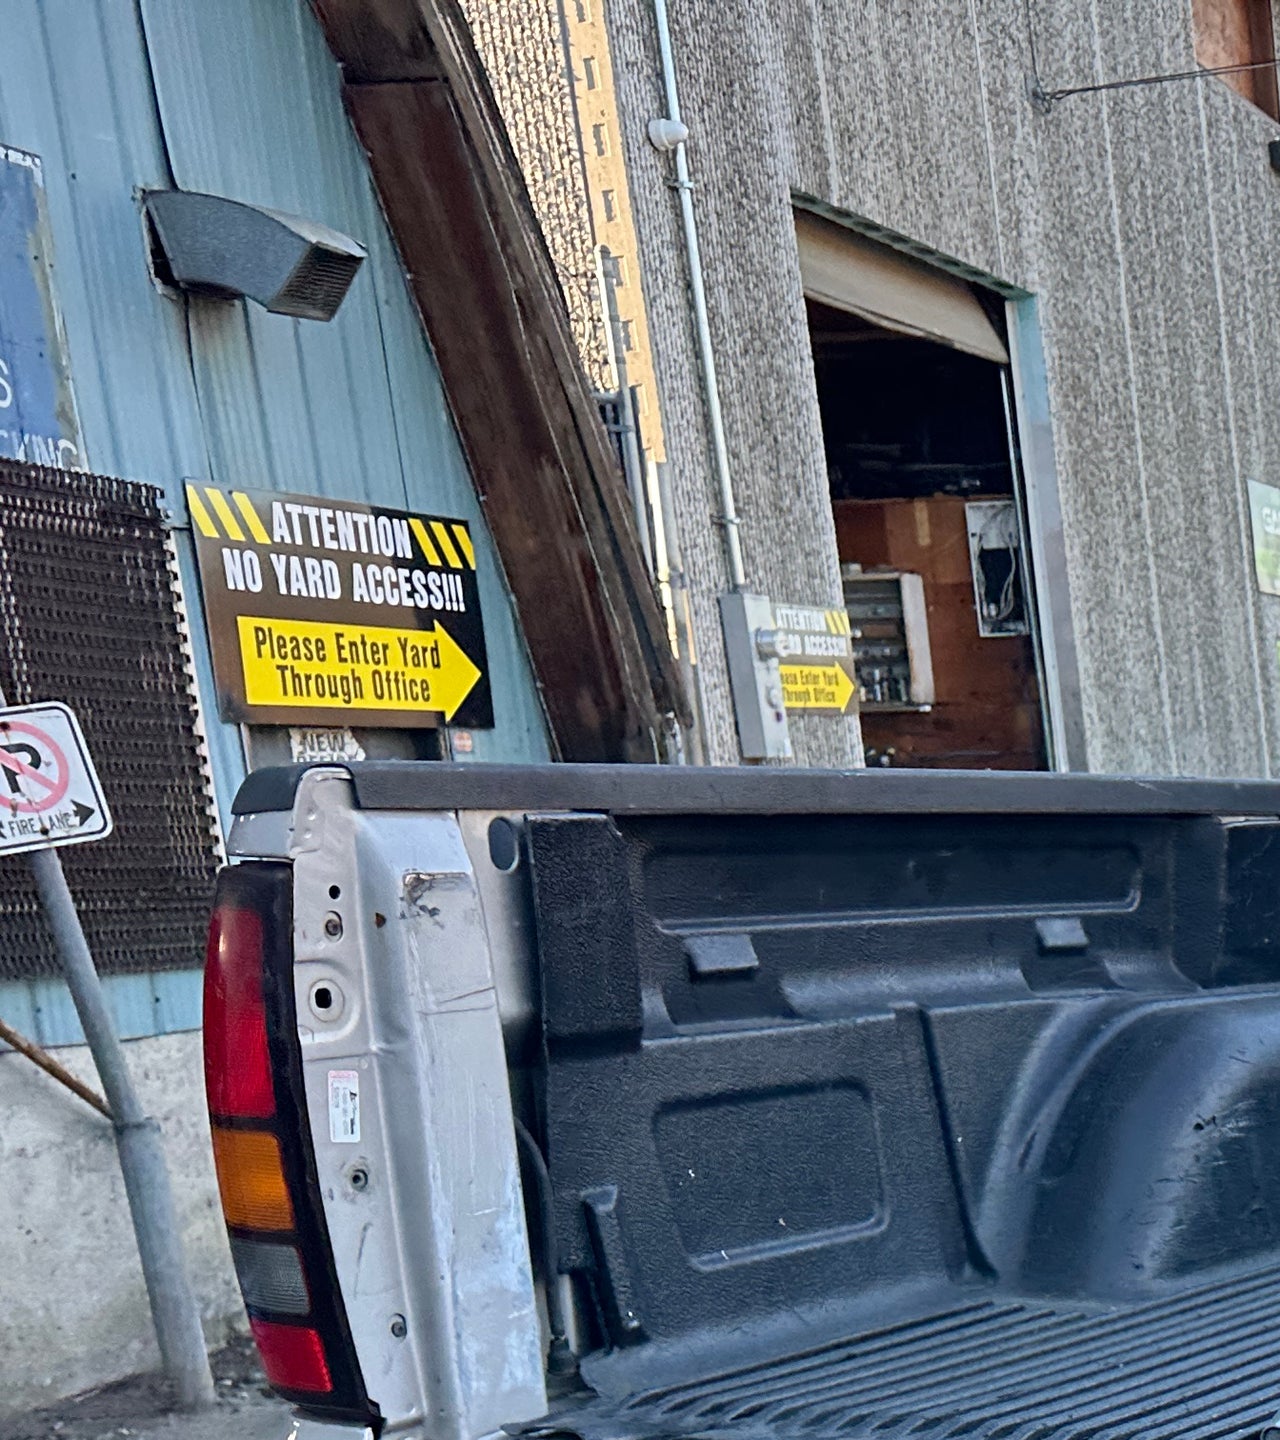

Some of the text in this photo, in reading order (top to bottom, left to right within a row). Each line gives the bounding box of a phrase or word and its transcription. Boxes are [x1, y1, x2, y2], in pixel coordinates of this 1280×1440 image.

[271, 501, 413, 560] ATTENTION
[222, 548, 466, 612] NO YARD ACCESS!!!
[254, 626, 442, 669] Please Enter Yard
[276, 665, 431, 704] Through Office
[8, 817, 36, 837] FIRE
